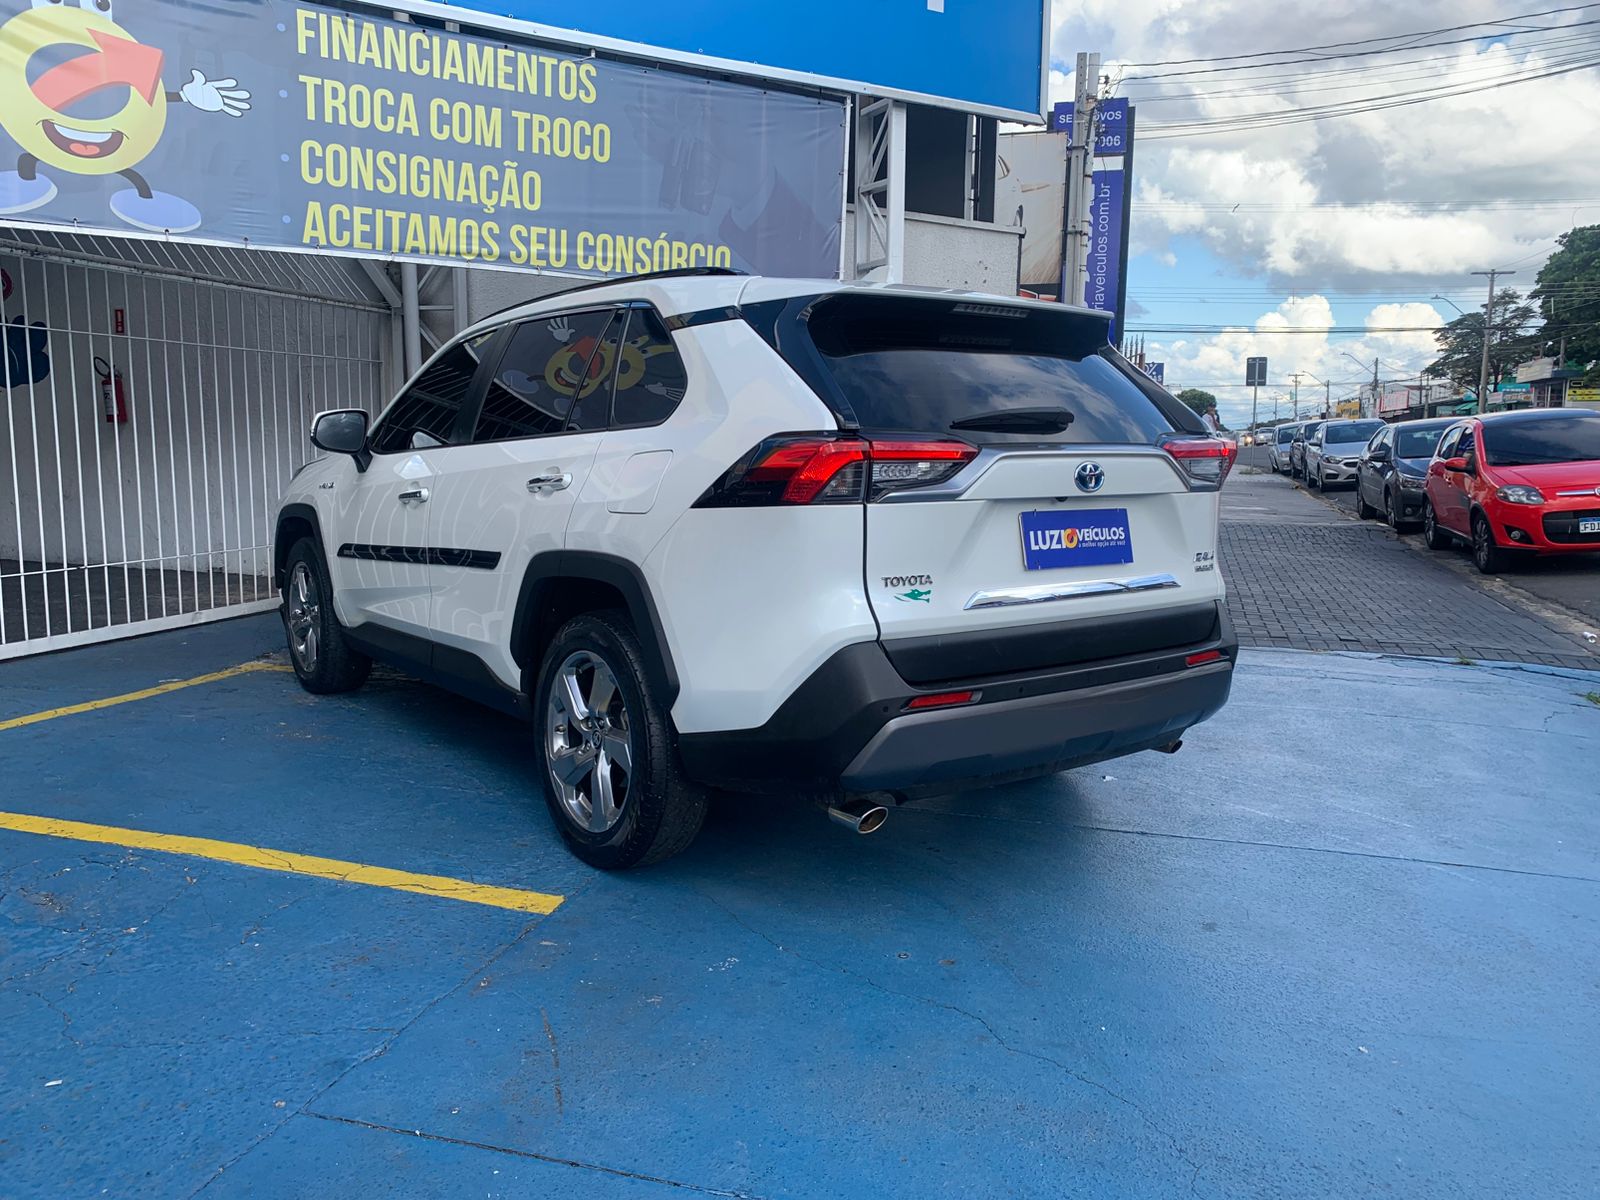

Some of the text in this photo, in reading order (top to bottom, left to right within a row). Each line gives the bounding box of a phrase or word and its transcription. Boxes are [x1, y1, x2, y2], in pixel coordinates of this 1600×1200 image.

[296, 8, 597, 104] FINANCIAMENTOS
[299, 74, 611, 163] TROCA COM TROCO
[300, 139, 542, 214] CONSIGNAÇÃO
[302, 201, 731, 274] ACEITAMOS SEU CONSÓRCIO
[1092, 183, 1111, 311] riaveiculos.com.br
[1029, 526, 1126, 550] LUZIO VEÍCULOS
[881, 574, 933, 588] TOYOTA
